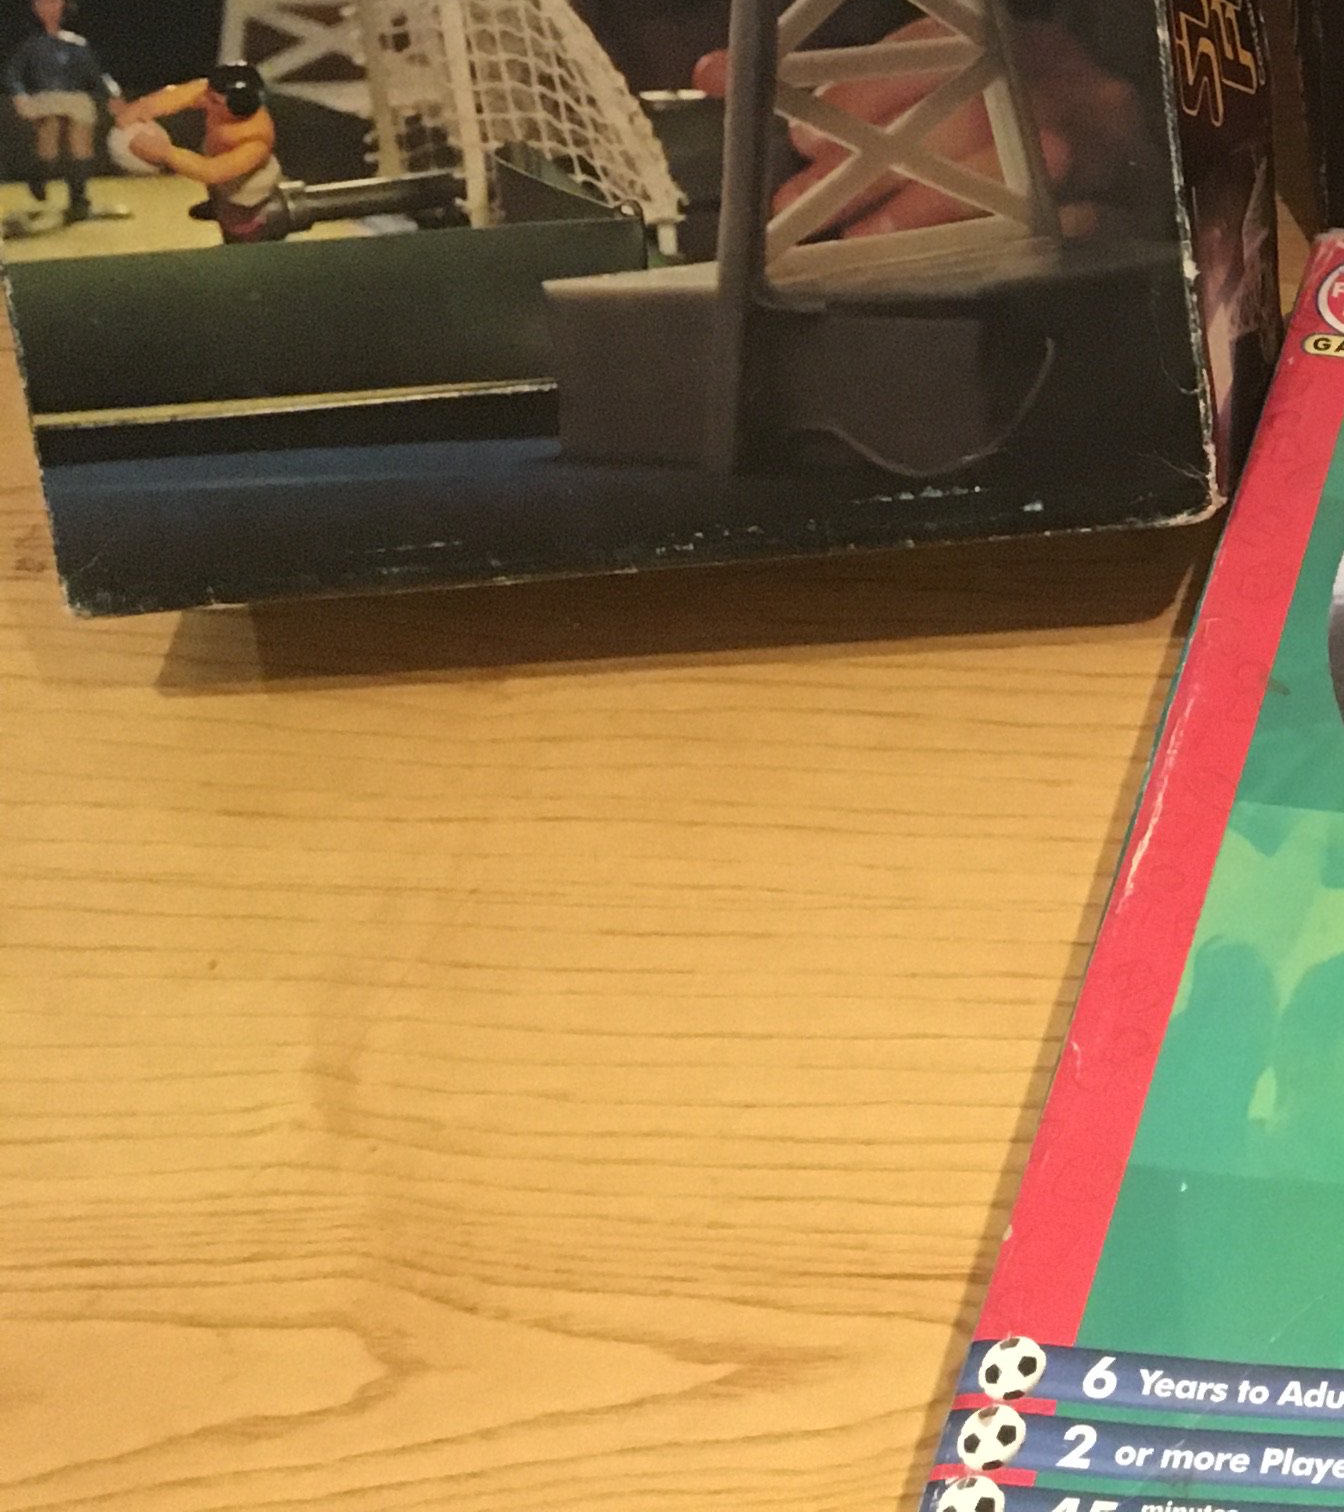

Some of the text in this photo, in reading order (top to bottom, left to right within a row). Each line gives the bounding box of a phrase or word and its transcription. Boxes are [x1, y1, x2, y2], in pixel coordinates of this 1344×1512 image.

[1081, 1355, 1119, 1400] 6
[1138, 1368, 1230, 1404] Years
[1236, 1374, 1271, 1405] to
[1054, 1424, 1099, 1470] 2
[1114, 1444, 1155, 1468] or
[1160, 1449, 1253, 1474] more
